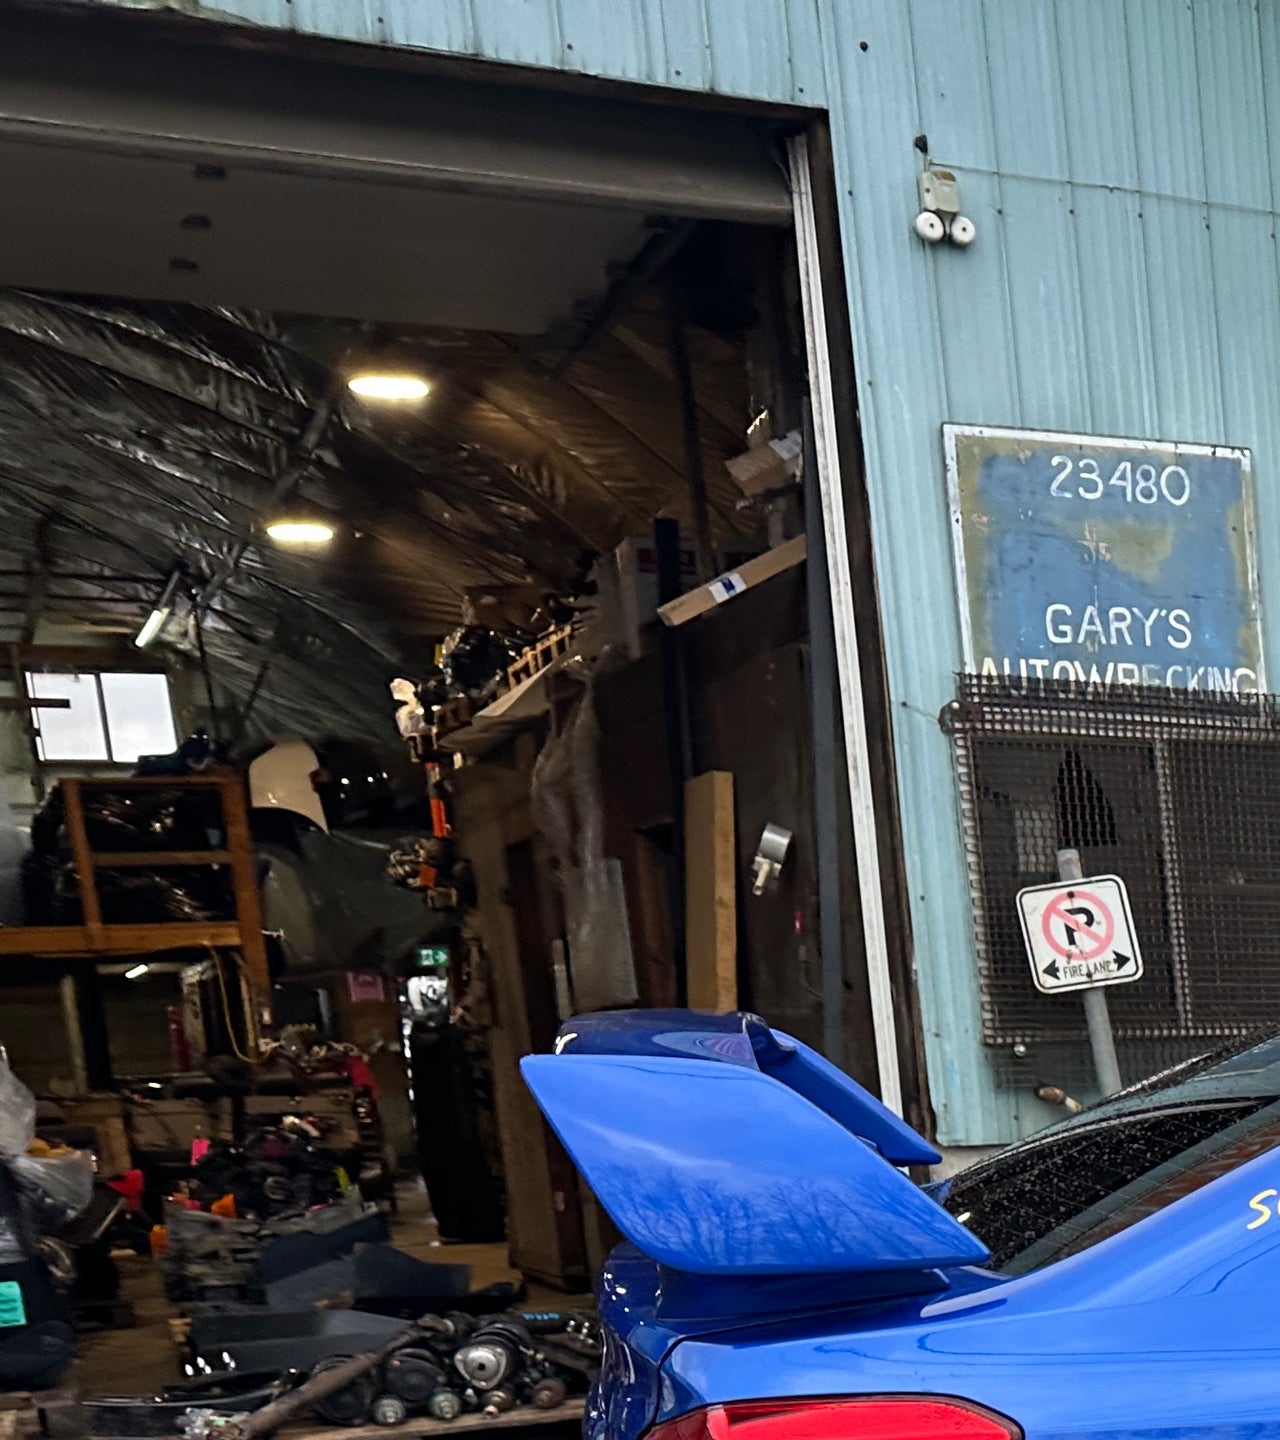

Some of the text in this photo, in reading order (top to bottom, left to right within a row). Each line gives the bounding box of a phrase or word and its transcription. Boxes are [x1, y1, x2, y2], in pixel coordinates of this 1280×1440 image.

[1050, 455, 1191, 506] 23480
[1045, 603, 1193, 650] GARY'S
[1063, 965, 1084, 979] FIRE
